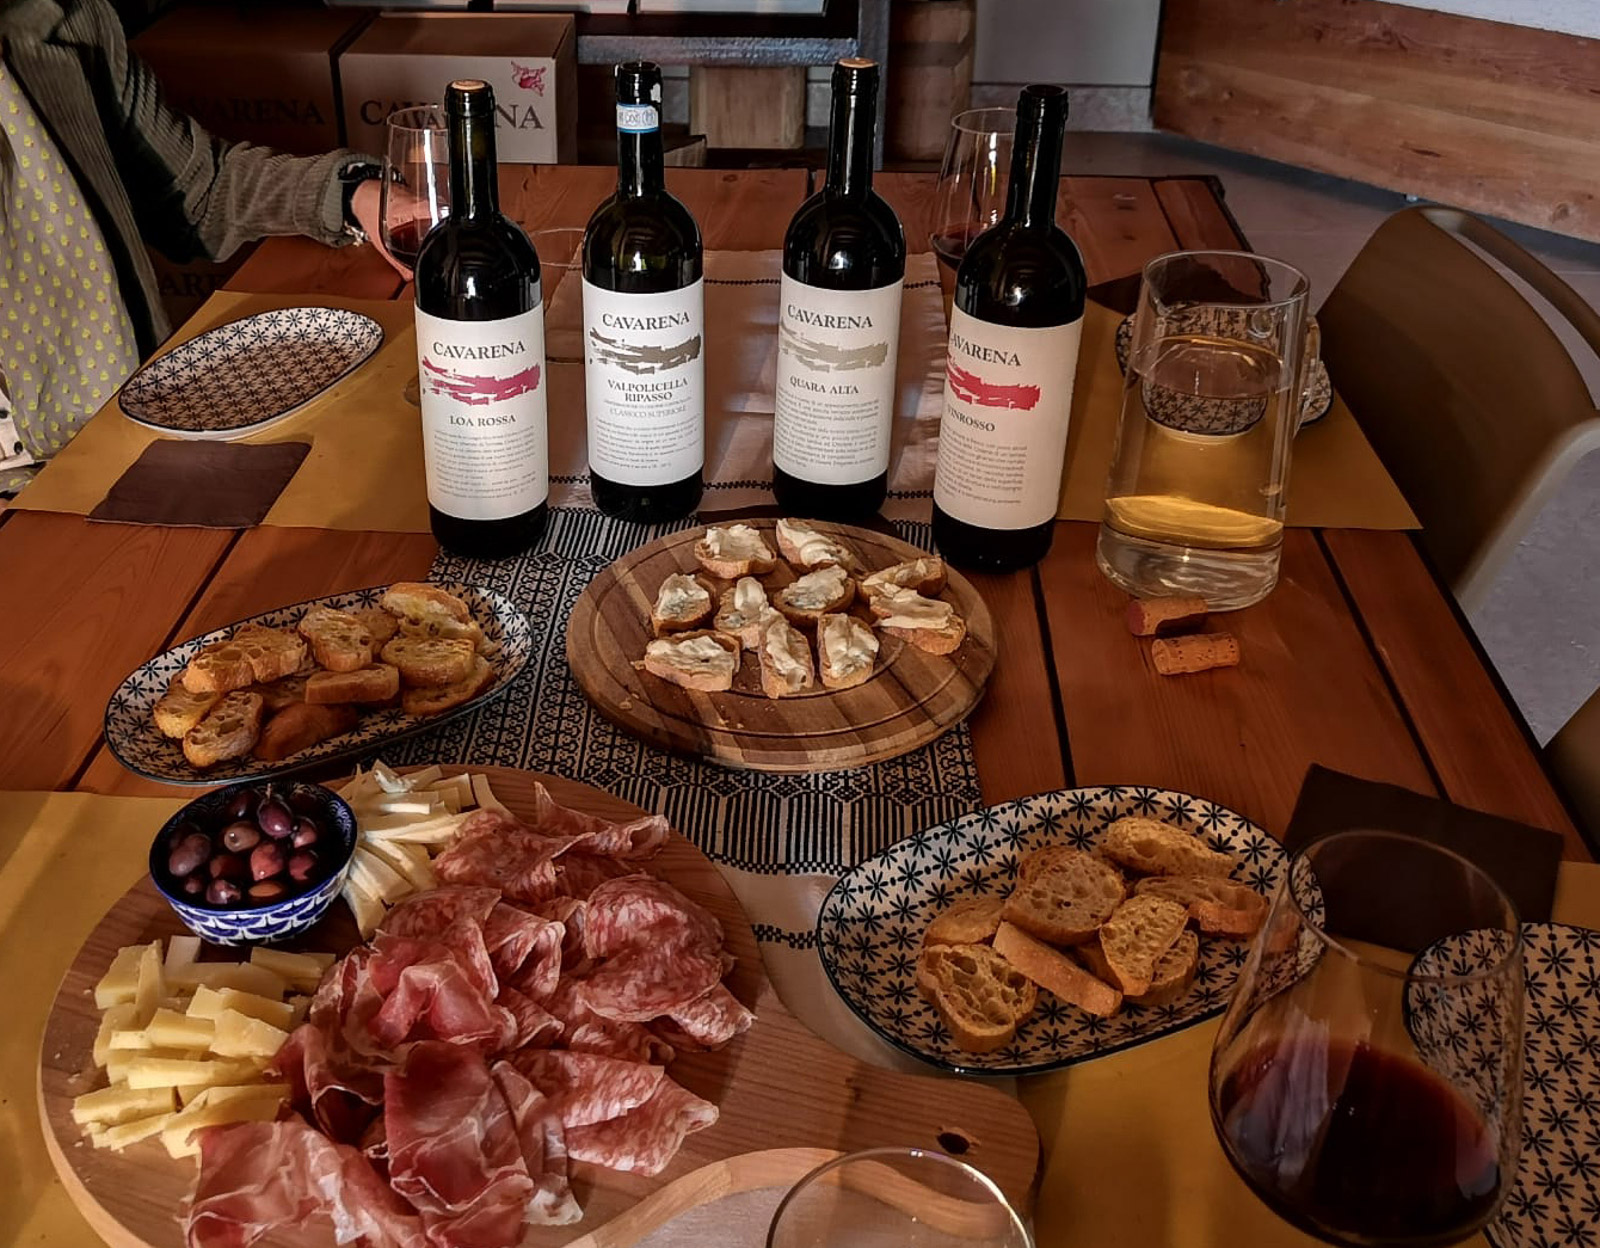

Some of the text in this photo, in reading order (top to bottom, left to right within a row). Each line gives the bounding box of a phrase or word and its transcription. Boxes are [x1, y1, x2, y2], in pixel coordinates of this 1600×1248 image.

[360, 99, 543, 130] CAVANA
[602, 311, 690, 331] CAVARENA
[787, 304, 873, 329] CAVARENA
[432, 340, 526, 360] CAVARENA
[950, 332, 1022, 367] AVARENA
[607, 377, 689, 393] VALPOLICELLA
[789, 375, 860, 395] QUARA ALTA
[625, 391, 673, 402] RIPASSO
[450, 414, 517, 427] LOA ROSSA
